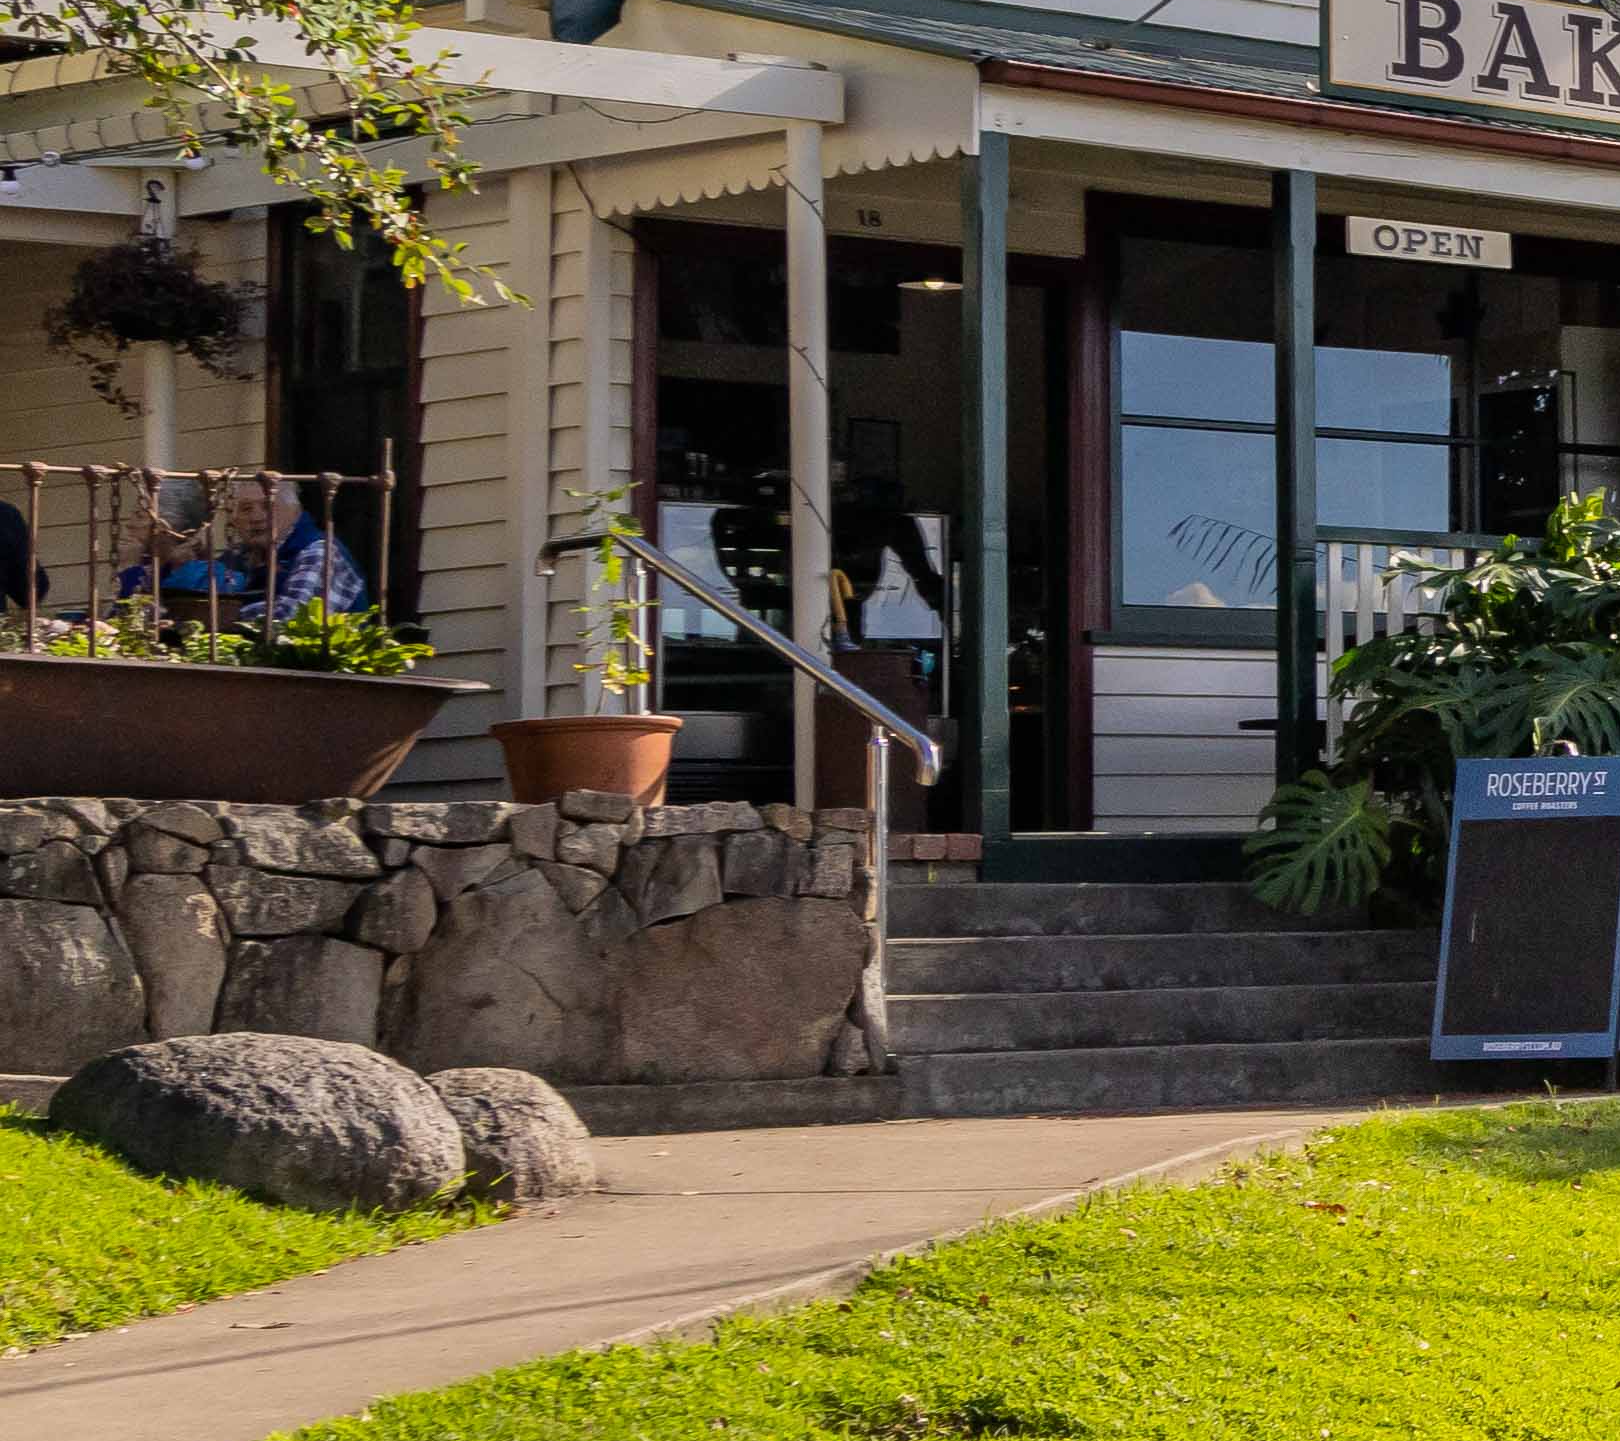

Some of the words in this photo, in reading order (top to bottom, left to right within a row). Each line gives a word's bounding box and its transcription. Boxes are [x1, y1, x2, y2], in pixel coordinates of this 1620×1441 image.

[1374, 225, 1484, 258] OPEN
[1487, 771, 1592, 797] ROSEBERRY
[1592, 771, 1608, 795] ST
